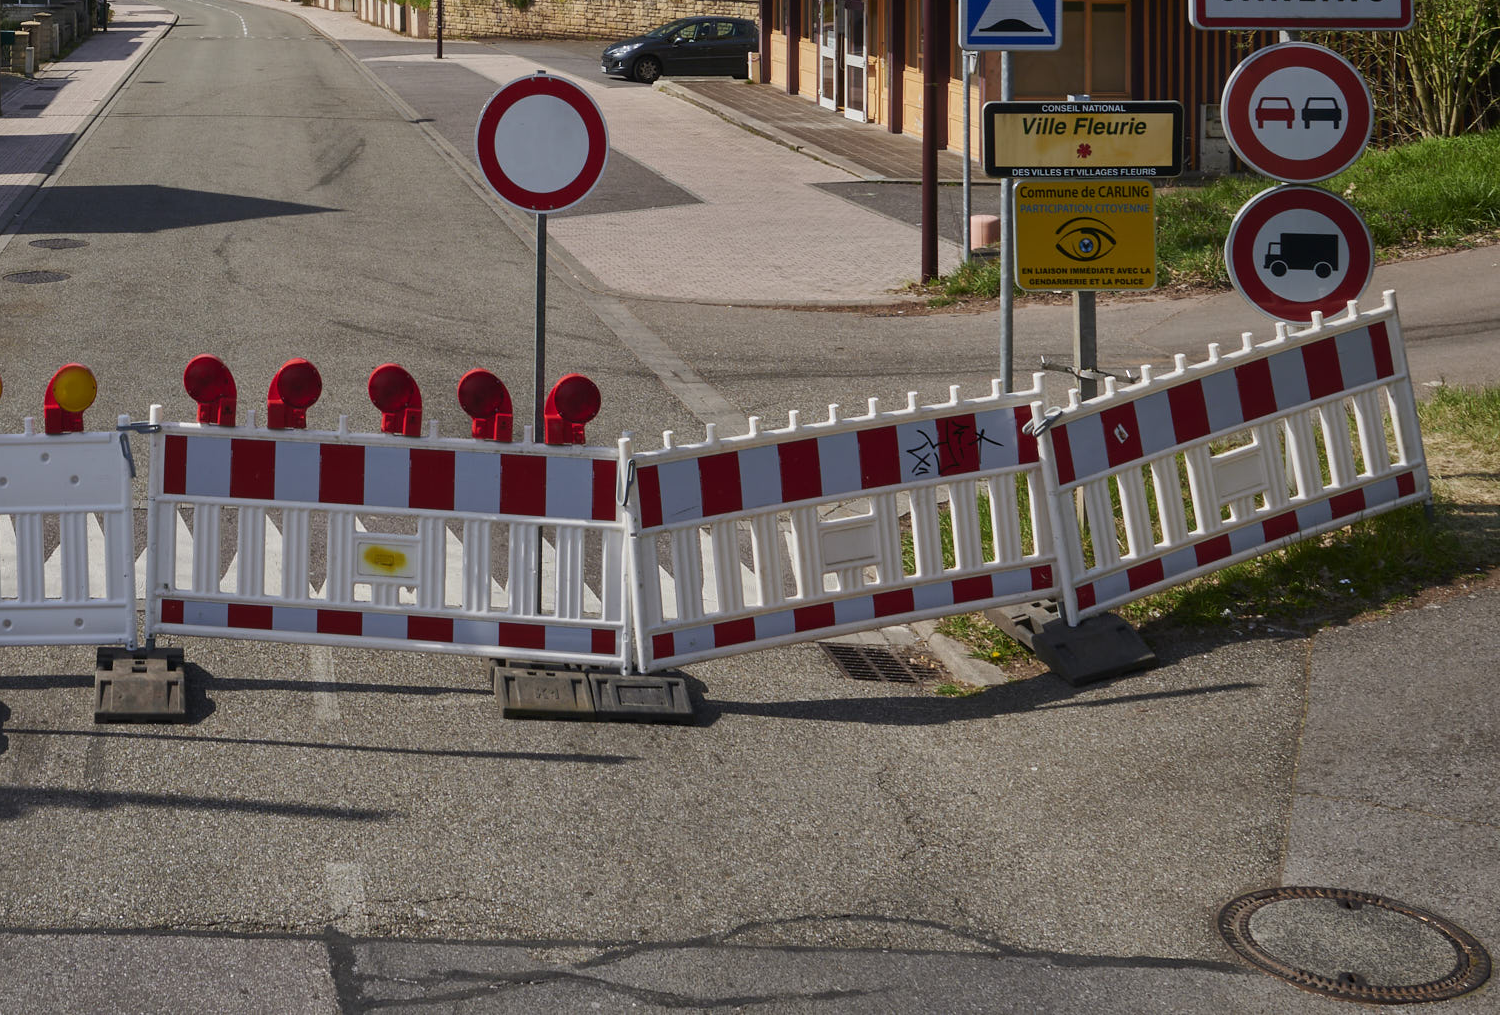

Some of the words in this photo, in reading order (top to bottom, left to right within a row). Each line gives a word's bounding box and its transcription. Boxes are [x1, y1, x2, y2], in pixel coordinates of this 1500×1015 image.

[1041, 104, 1080, 113] CONSEIL
[1082, 104, 1126, 112] NATIONAL
[1022, 117, 1067, 135] Ville
[1073, 117, 1147, 135] Fleurie
[1012, 168, 1030, 176] DES
[1031, 168, 1062, 176] VILLES
[1064, 168, 1075, 176] ET
[1076, 168, 1118, 176] VILLAGES
[1120, 167, 1157, 176] FLEURIS
[1020, 186, 1078, 198] Commune
[1081, 186, 1095, 198] de
[1098, 185, 1149, 198] CARLING
[1020, 203, 1092, 214] PARTICIPATION
[1095, 203, 1150, 213] CITOYENNE
[1070, 266, 1115, 274] IMMÉDIATE
